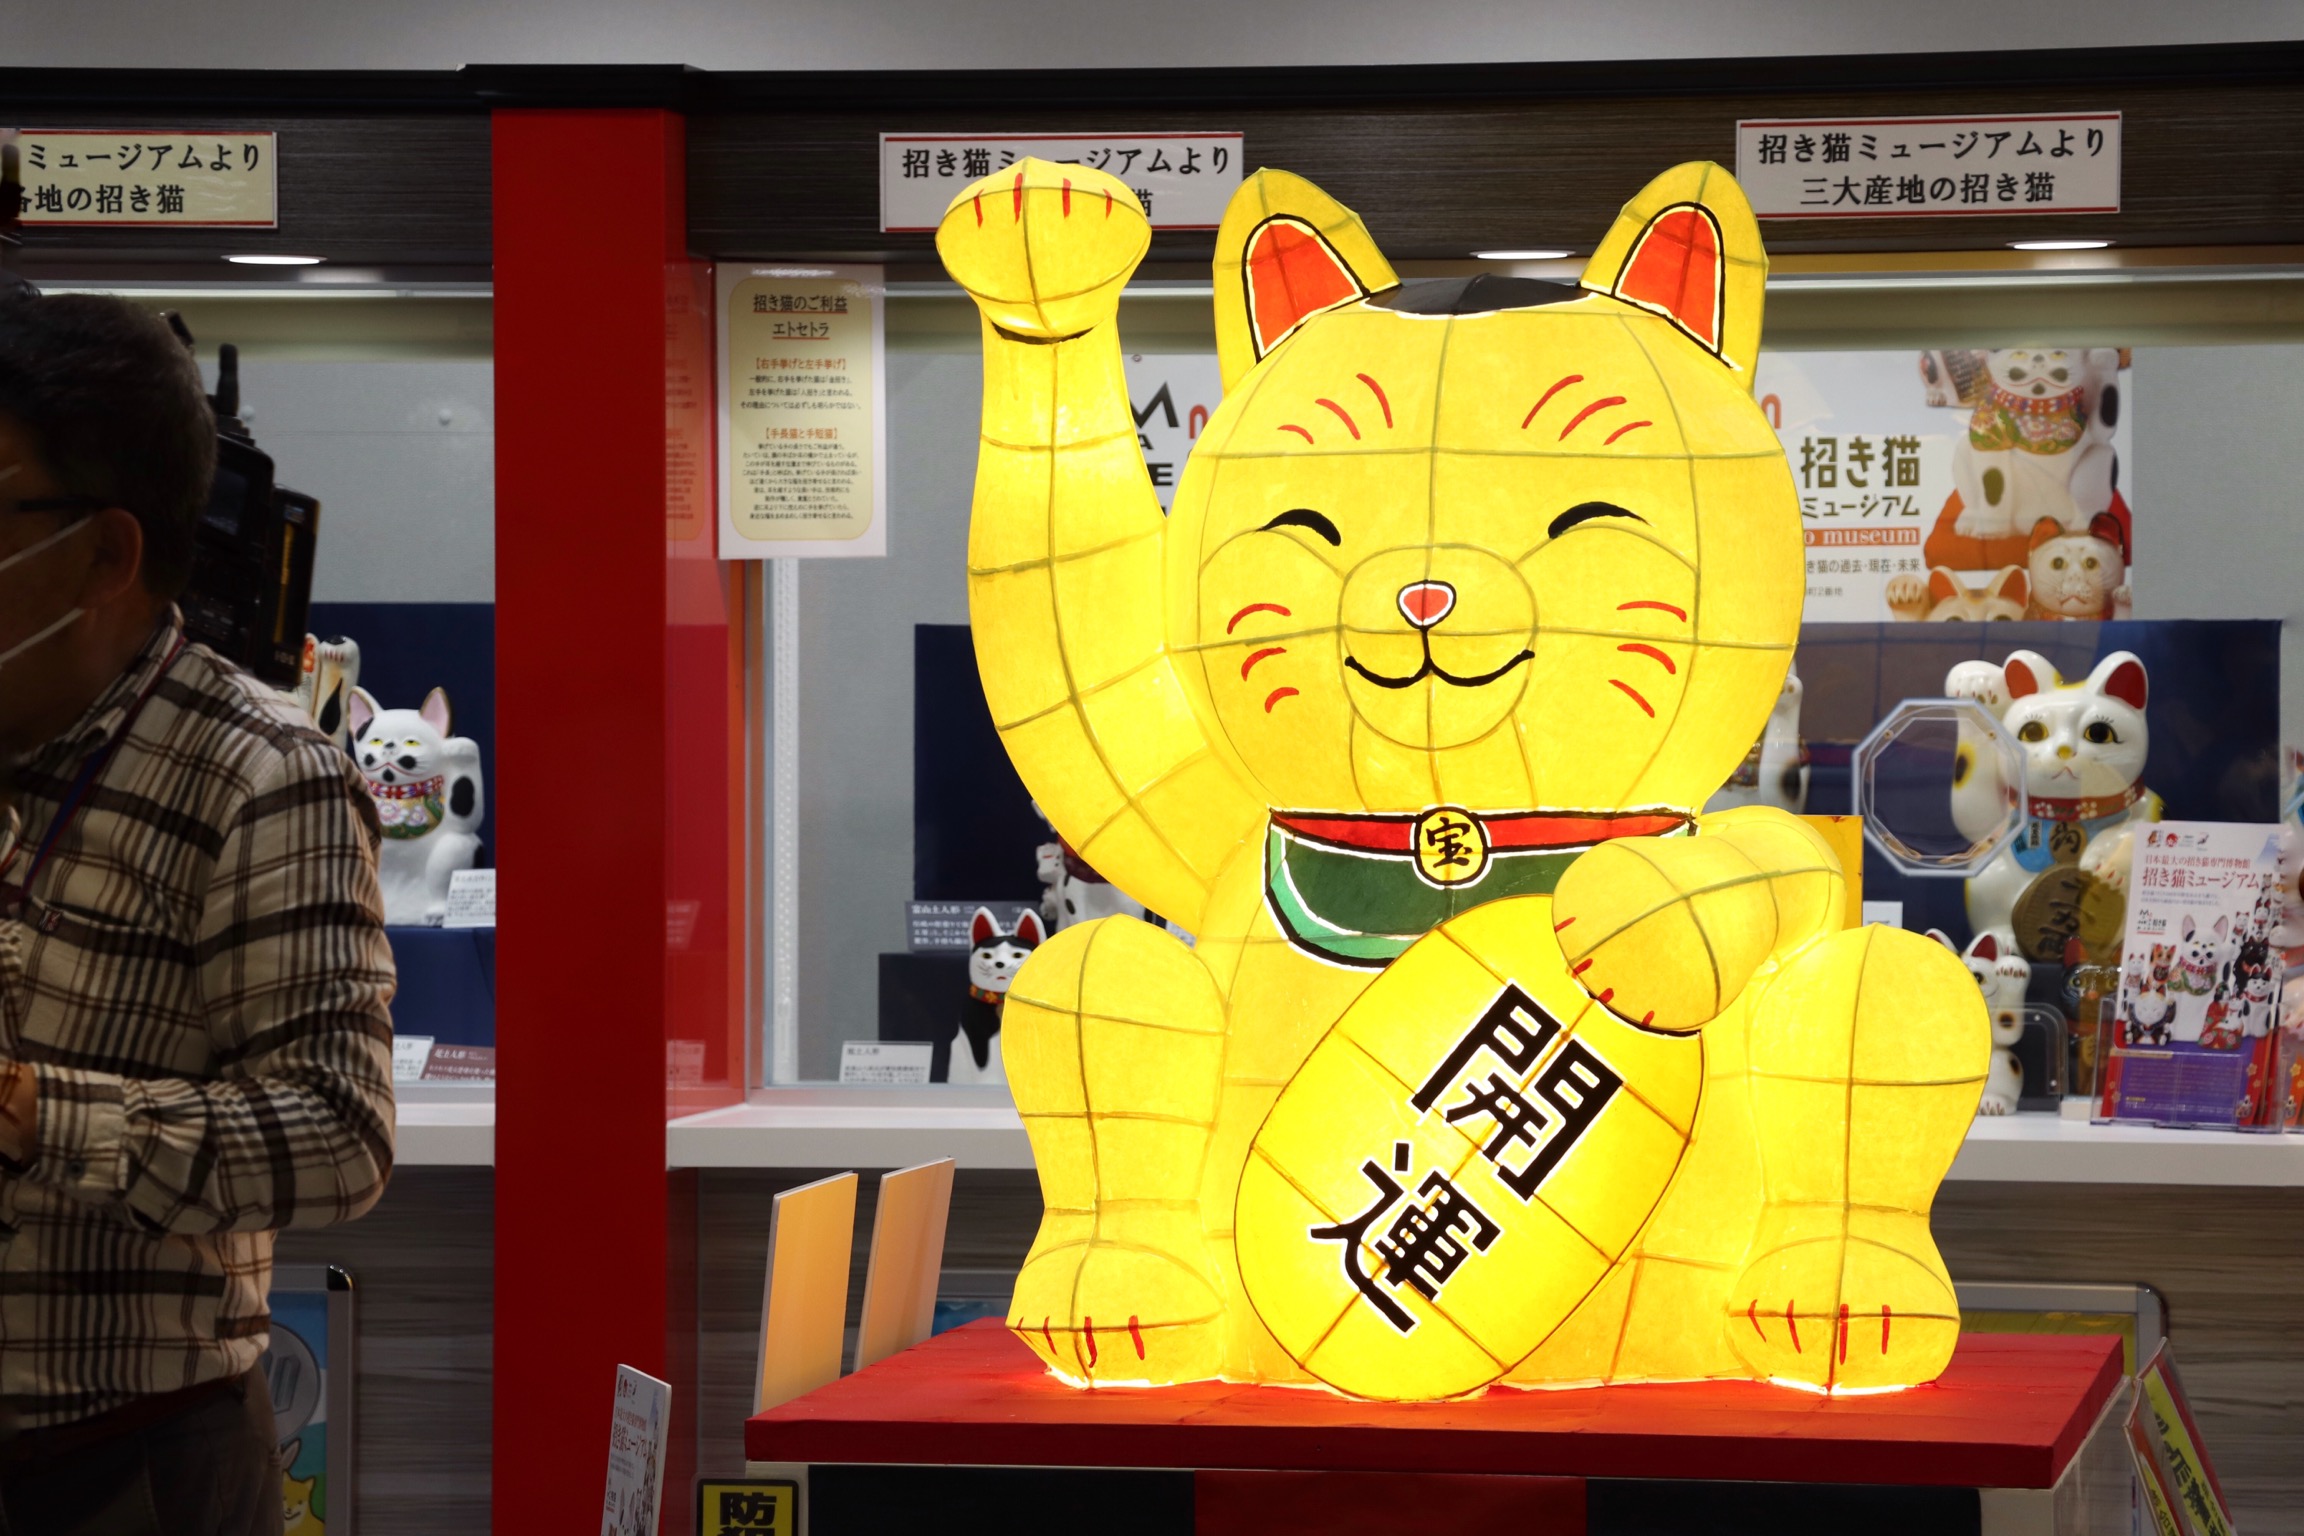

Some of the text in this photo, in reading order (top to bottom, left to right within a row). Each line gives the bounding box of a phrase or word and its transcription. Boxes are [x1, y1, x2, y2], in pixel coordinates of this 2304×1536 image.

[28, 143, 260, 172] ミュージアムより
[902, 145, 1230, 178] 招き猫ミージアムより
[1758, 128, 2104, 165] 招き猫ミュージアムより
[1800, 171, 2056, 206] 三大産地の招き猫
[753, 293, 848, 312] 招き猫のご利益
[773, 320, 829, 337] エトセトラ
[1800, 435, 1921, 488] 招き猫
[1801, 493, 1921, 519] ミュージアム
[1823, 528, 1919, 545] museum
[1426, 816, 1473, 869] 宝
[2142, 866, 2260, 889] 招き猫ミュージアム
[1310, 983, 1624, 1334] 開運
[719, 1491, 778, 1536] 防
